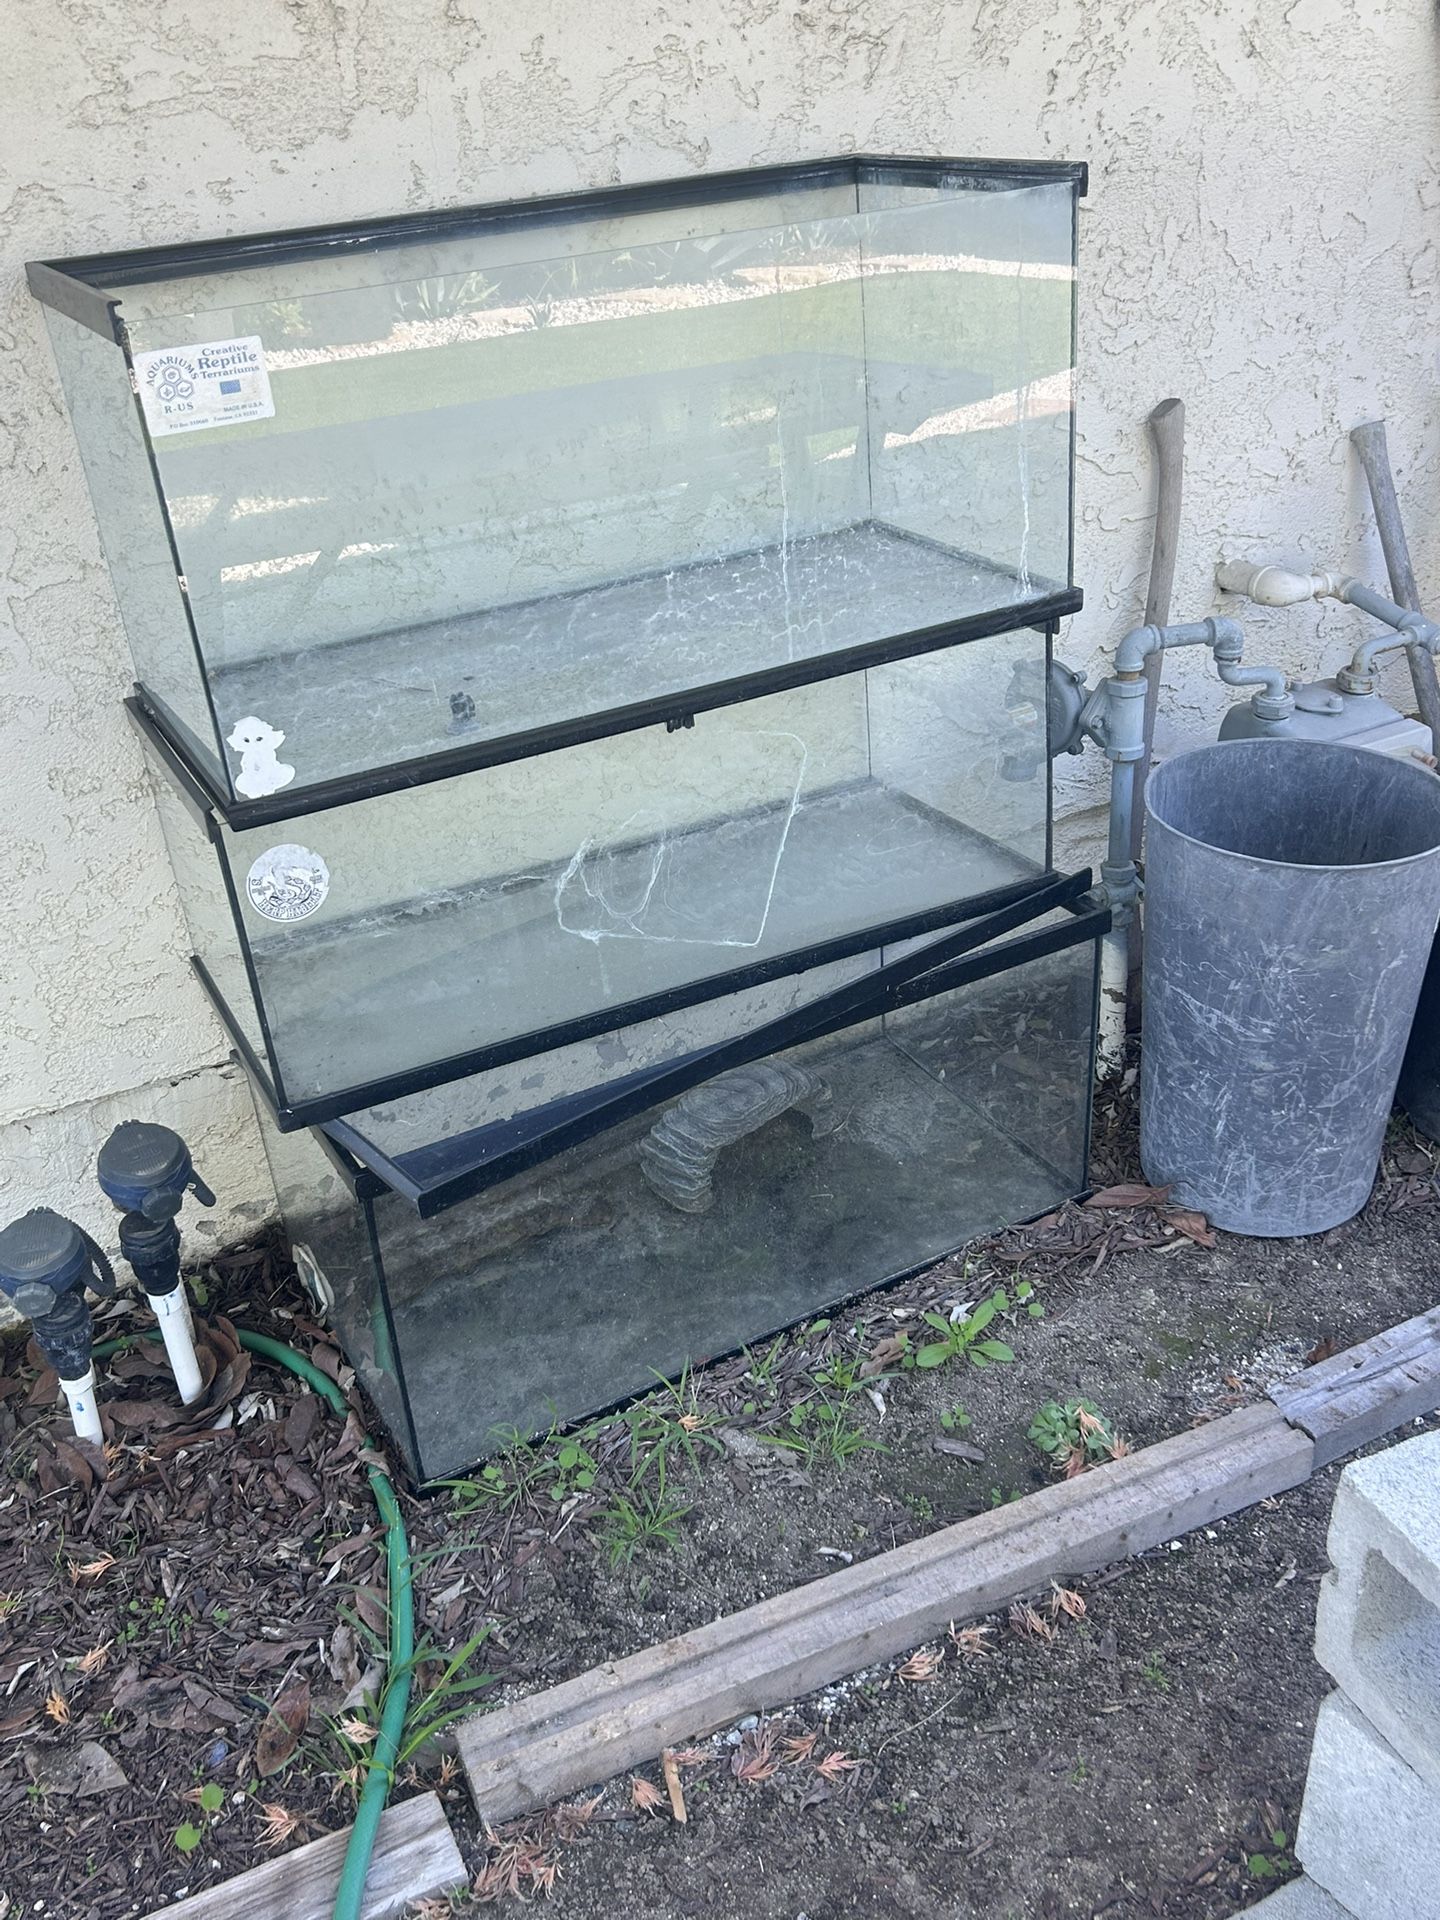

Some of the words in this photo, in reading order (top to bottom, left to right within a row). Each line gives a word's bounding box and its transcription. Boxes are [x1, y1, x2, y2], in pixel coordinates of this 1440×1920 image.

[201, 345, 248, 357] Creative
[197, 352, 257, 370] Reptile
[146, 355, 199, 387] AQUARIUMS
[200, 365, 260, 379] Terrariums
